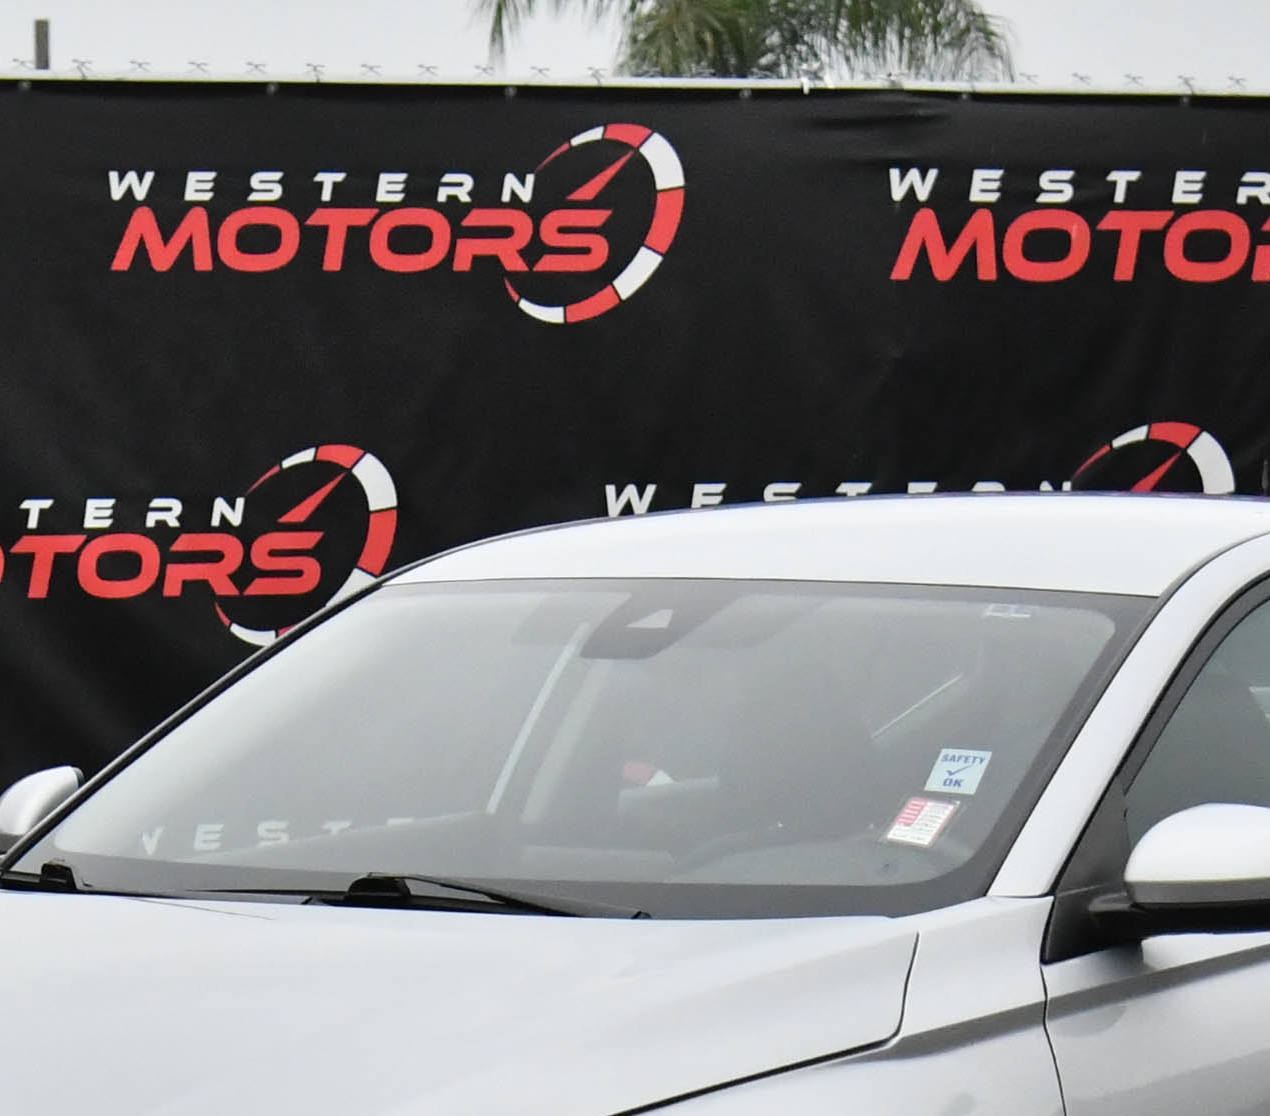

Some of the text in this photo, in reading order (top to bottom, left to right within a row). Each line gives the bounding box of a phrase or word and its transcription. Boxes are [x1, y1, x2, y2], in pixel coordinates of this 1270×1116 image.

[108, 170, 535, 203] WESTERN
[110, 205, 613, 273] MOTORS
[940, 753, 986, 765] SAFETY
[942, 777, 964, 788] OK
